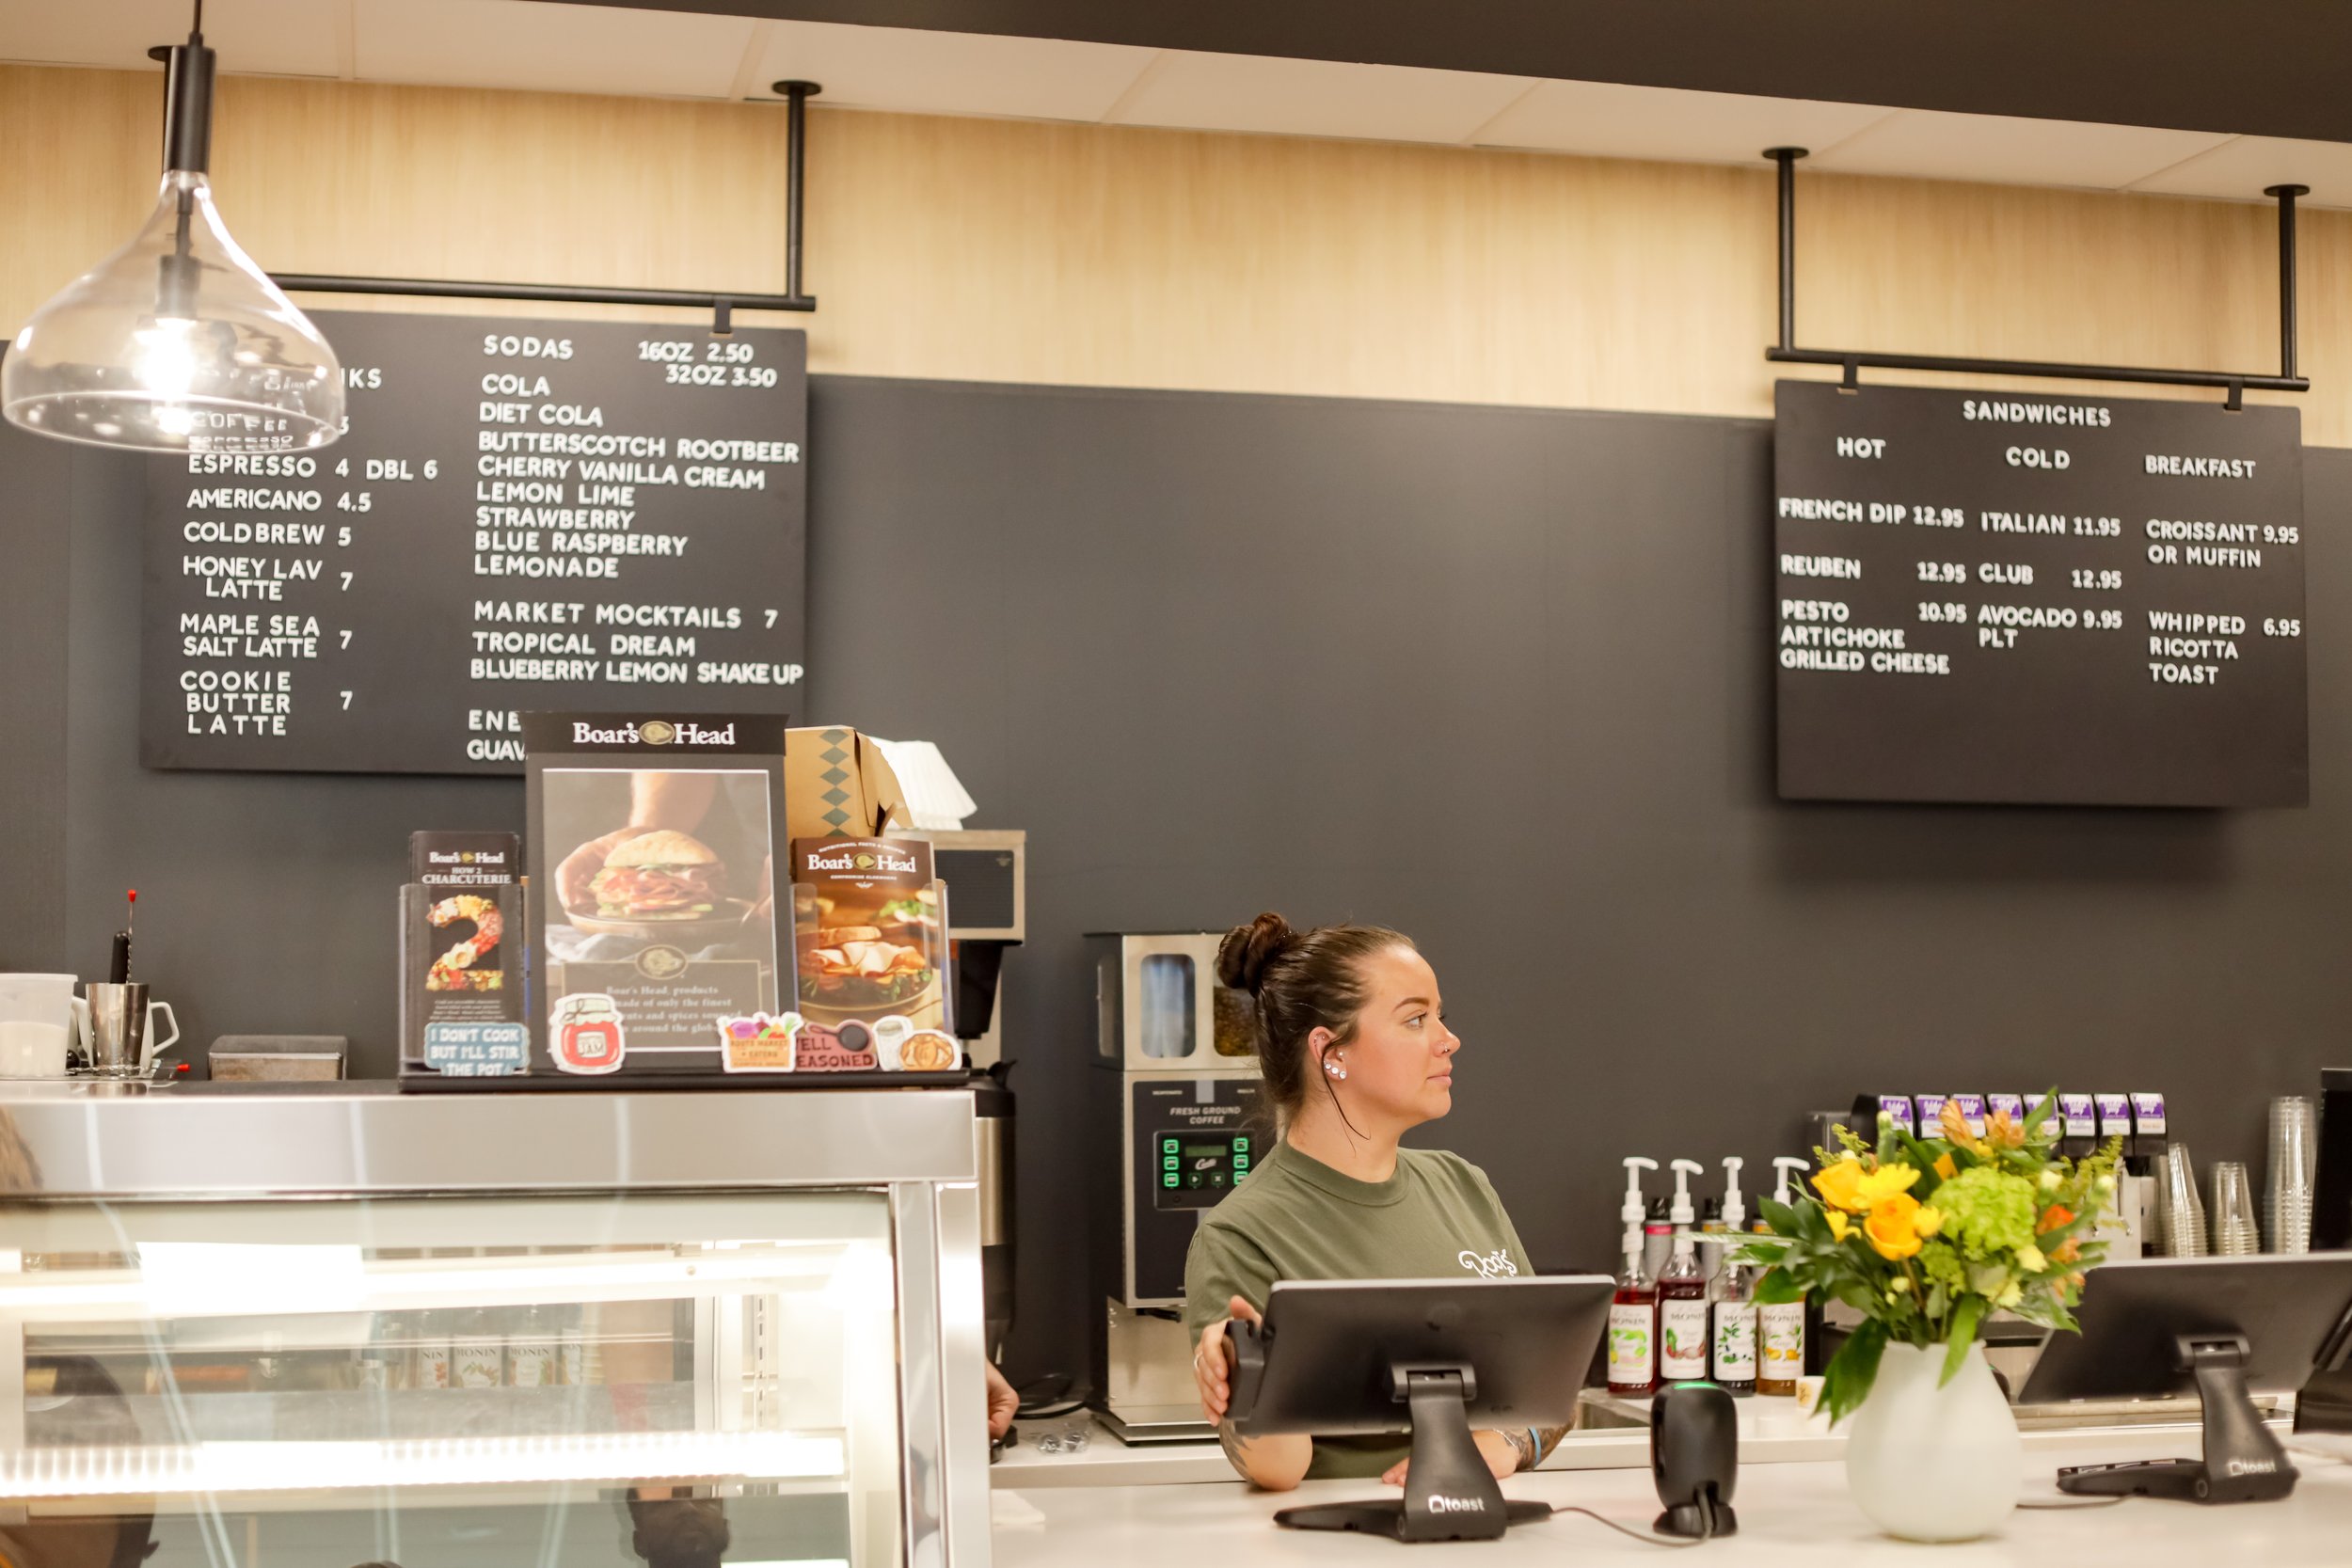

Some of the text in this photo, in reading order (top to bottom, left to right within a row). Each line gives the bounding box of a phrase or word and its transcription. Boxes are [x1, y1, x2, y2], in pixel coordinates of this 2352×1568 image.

[484, 334, 574, 359] SODAS
[707, 342, 755, 364] 2.50
[481, 373, 551, 397] COLA
[731, 366, 778, 388] 3.50
[479, 401, 603, 428] DIET COLA
[1963, 400, 2111, 427] SANDWICHES
[478, 430, 800, 463] BUTTERSCOTCH ROOTBEER
[1836, 436, 1886, 459] HOT
[2006, 446, 2071, 469] COLD
[188, 453, 438, 481] ESPRESSO 4 DBL 6
[477, 454, 765, 490] CHERRY VANILLA CREAM
[2145, 454, 2256, 479] BREAKFAST
[186, 487, 372, 513] AMERICANO 4.5
[476, 480, 635, 507] LEMON LIME
[476, 505, 635, 531] STRAWBERRY
[1778, 497, 1964, 528] FRENCH DIP 12.95
[1981, 512, 2122, 536] ITALIAN 11.95
[183, 521, 352, 546] COLD BREW 5
[2146, 518, 2299, 545] CROISSANT 9.95
[475, 530, 688, 557] BLUE RASPBERRY
[183, 555, 323, 580] HONEY LAV
[474, 553, 619, 578] LEMONADE
[2148, 544, 2261, 568] OR MUFFIN
[1780, 554, 1967, 583] REUBEN 12.95
[1979, 562, 2122, 590] CLUB 12.95
[205, 577, 283, 601] LATTE
[340, 571, 354, 591] 7
[474, 600, 778, 629] MARKET MOCKTAILS 7
[1781, 599, 1967, 624] PESTO 10.95
[1978, 604, 2122, 629] AVOCADO 9.95
[180, 612, 321, 637] MAPLE SEA
[2148, 610, 2301, 637] WHIPPED 6.95
[183, 635, 317, 658] SALT LATTE
[339, 629, 353, 650] 7
[471, 631, 695, 657] TROPICAL DREAM
[1780, 625, 1906, 649] ARTICHOKE
[1979, 627, 2019, 648] PLT
[2149, 636, 2239, 659] RICOTTA
[470, 657, 804, 685] BLUEBERRY LEMON SHAKE UP
[1780, 647, 1950, 674] GRILLED CHEESE
[180, 670, 292, 692] COOKIE
[2149, 662, 2219, 685] TOAST
[186, 692, 291, 714] BUTTER
[340, 690, 353, 710] 7
[187, 713, 287, 736] LATTE
[469, 709, 521, 732] ENE
[572, 721, 736, 746] Boar's Head
[467, 738, 525, 761] GUAV
[430, 852, 504, 863] Boar's Head
[808, 853, 916, 872] Boar's Head
[421, 875, 512, 884] CHARCUTERIE
[673, 987, 718, 996] products
[643, 999, 654, 1007] of
[657, 999, 678, 1008] only
[632, 1023, 668, 1032] around
[672, 1023, 689, 1032] the
[646, 1010, 665, 1020] and
[668, 1012, 699, 1022] spices
[431, 1029, 519, 1041] I DON'T COOK
[797, 1037, 831, 1051] ELL
[431, 1046, 458, 1059] BUT
[489, 1046, 519, 1059] STIR
[580, 1041, 603, 1054] JAM
[446, 1064, 502, 1076] THE POT
[797, 1054, 874, 1067] EASONED
[1202, 1106, 1241, 1115] GROUND
[456, 1348, 496, 1357] MONIN
[510, 1347, 549, 1356] MONIN
[2243, 1459, 2277, 1474] toast
[1445, 1497, 1485, 1512] toast
